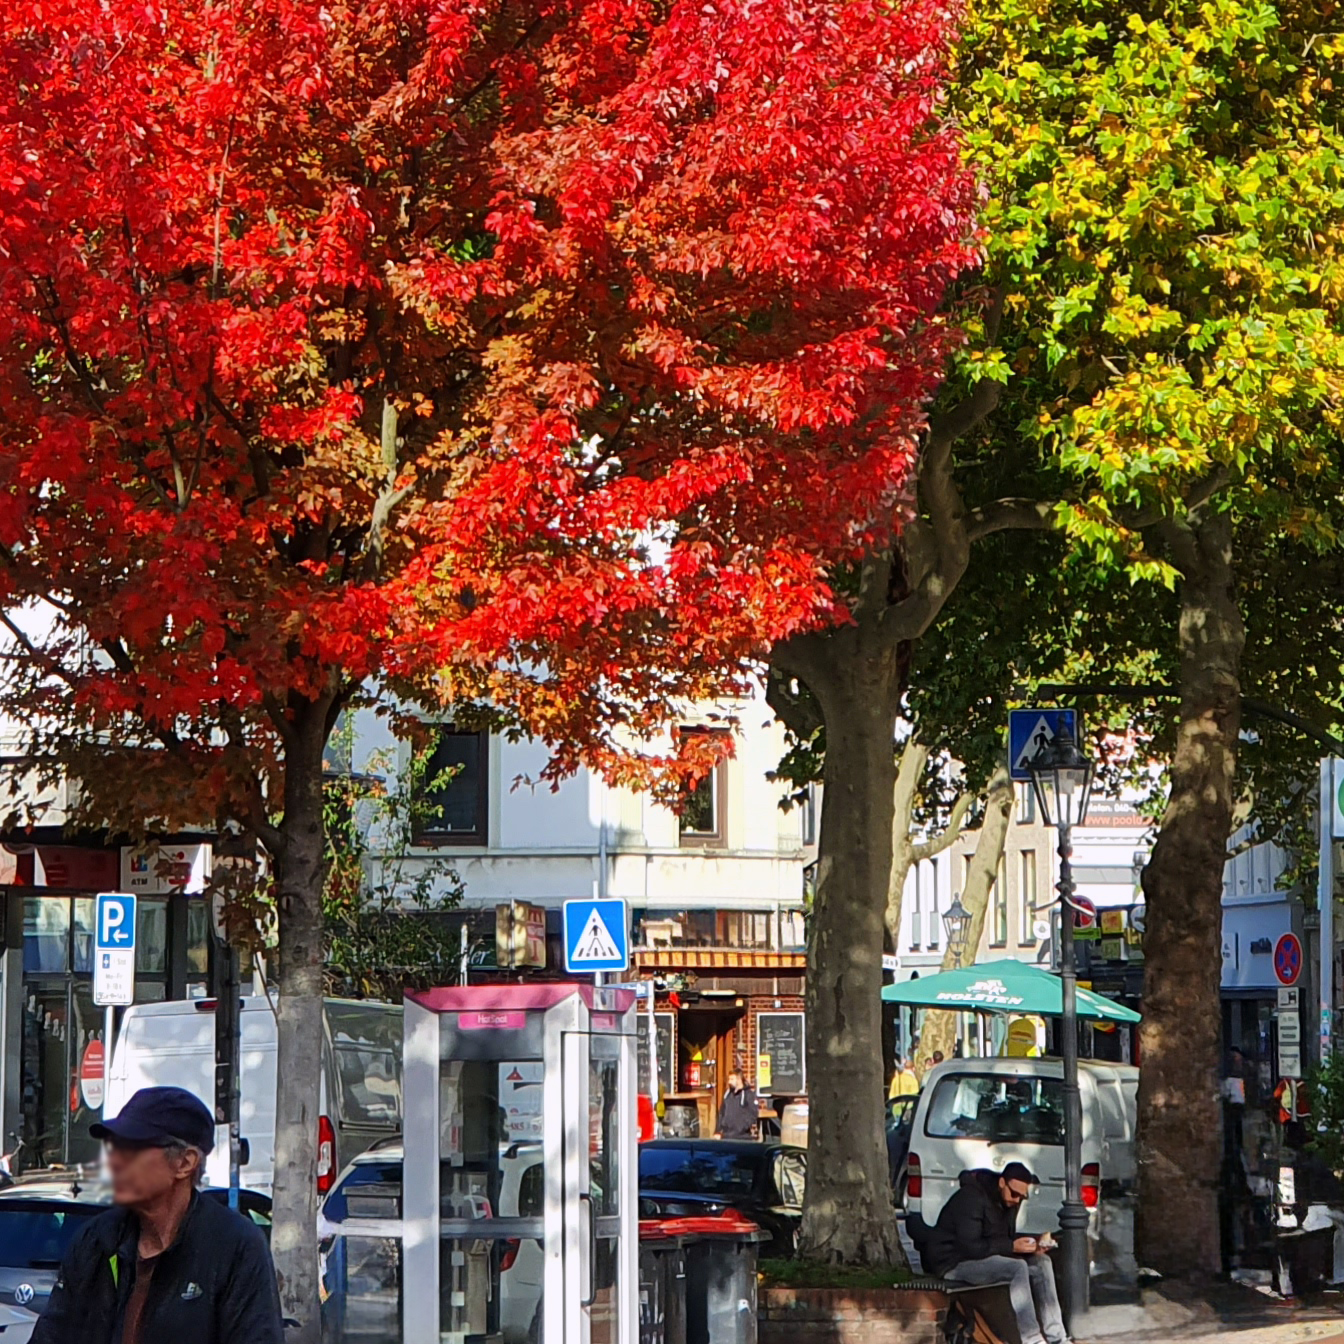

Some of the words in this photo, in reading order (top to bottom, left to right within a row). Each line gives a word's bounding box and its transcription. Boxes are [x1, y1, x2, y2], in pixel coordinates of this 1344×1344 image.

[130, 877, 148, 886] ATM
[102, 901, 125, 943] P
[936, 992, 1024, 1006] HOLSTEN
